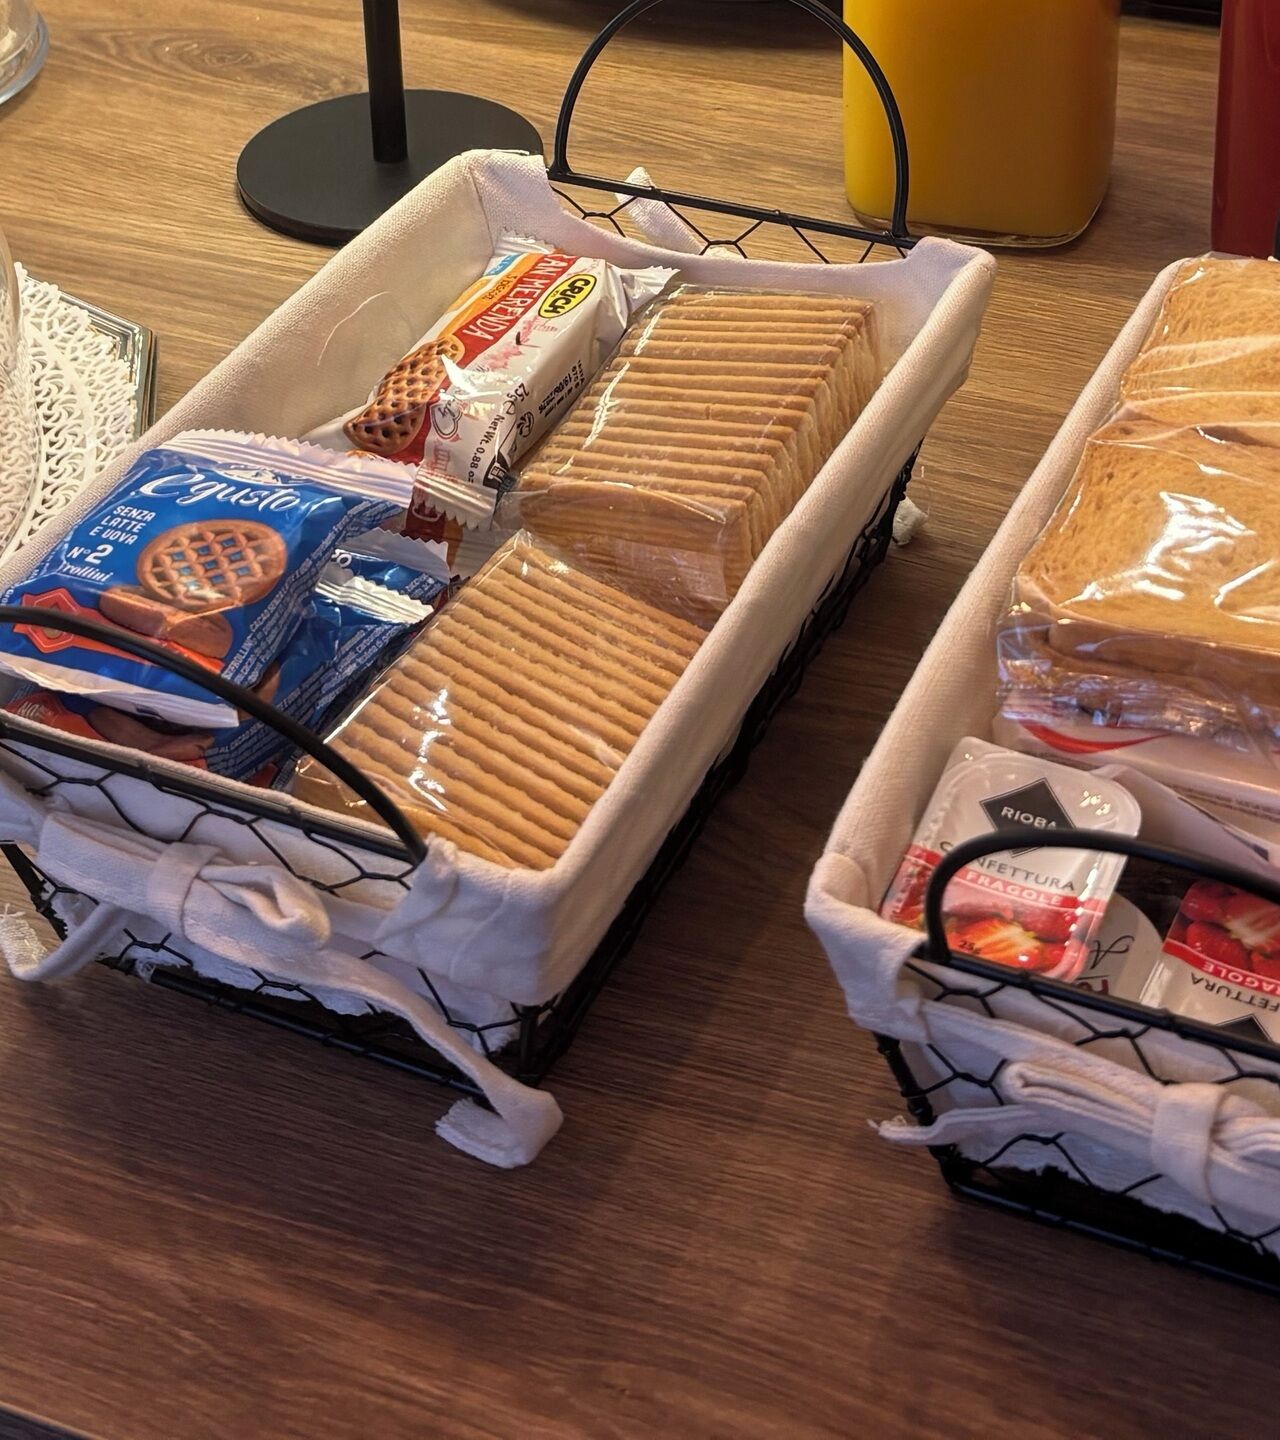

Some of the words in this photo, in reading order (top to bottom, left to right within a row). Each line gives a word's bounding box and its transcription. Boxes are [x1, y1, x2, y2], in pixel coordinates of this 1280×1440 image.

[544, 278, 590, 313] CRICH
[462, 277, 550, 340] MERENDA
[494, 414, 505, 430] Net
[470, 447, 486, 473] 0.88
[101, 515, 147, 533] LATTE
[113, 505, 156, 522] SENZA
[90, 525, 102, 536] E
[103, 529, 138, 546] UOVA
[58, 561, 113, 582] rollini
[1001, 806, 1058, 830] RIOBA
[966, 871, 1063, 905] FRAGOLE
